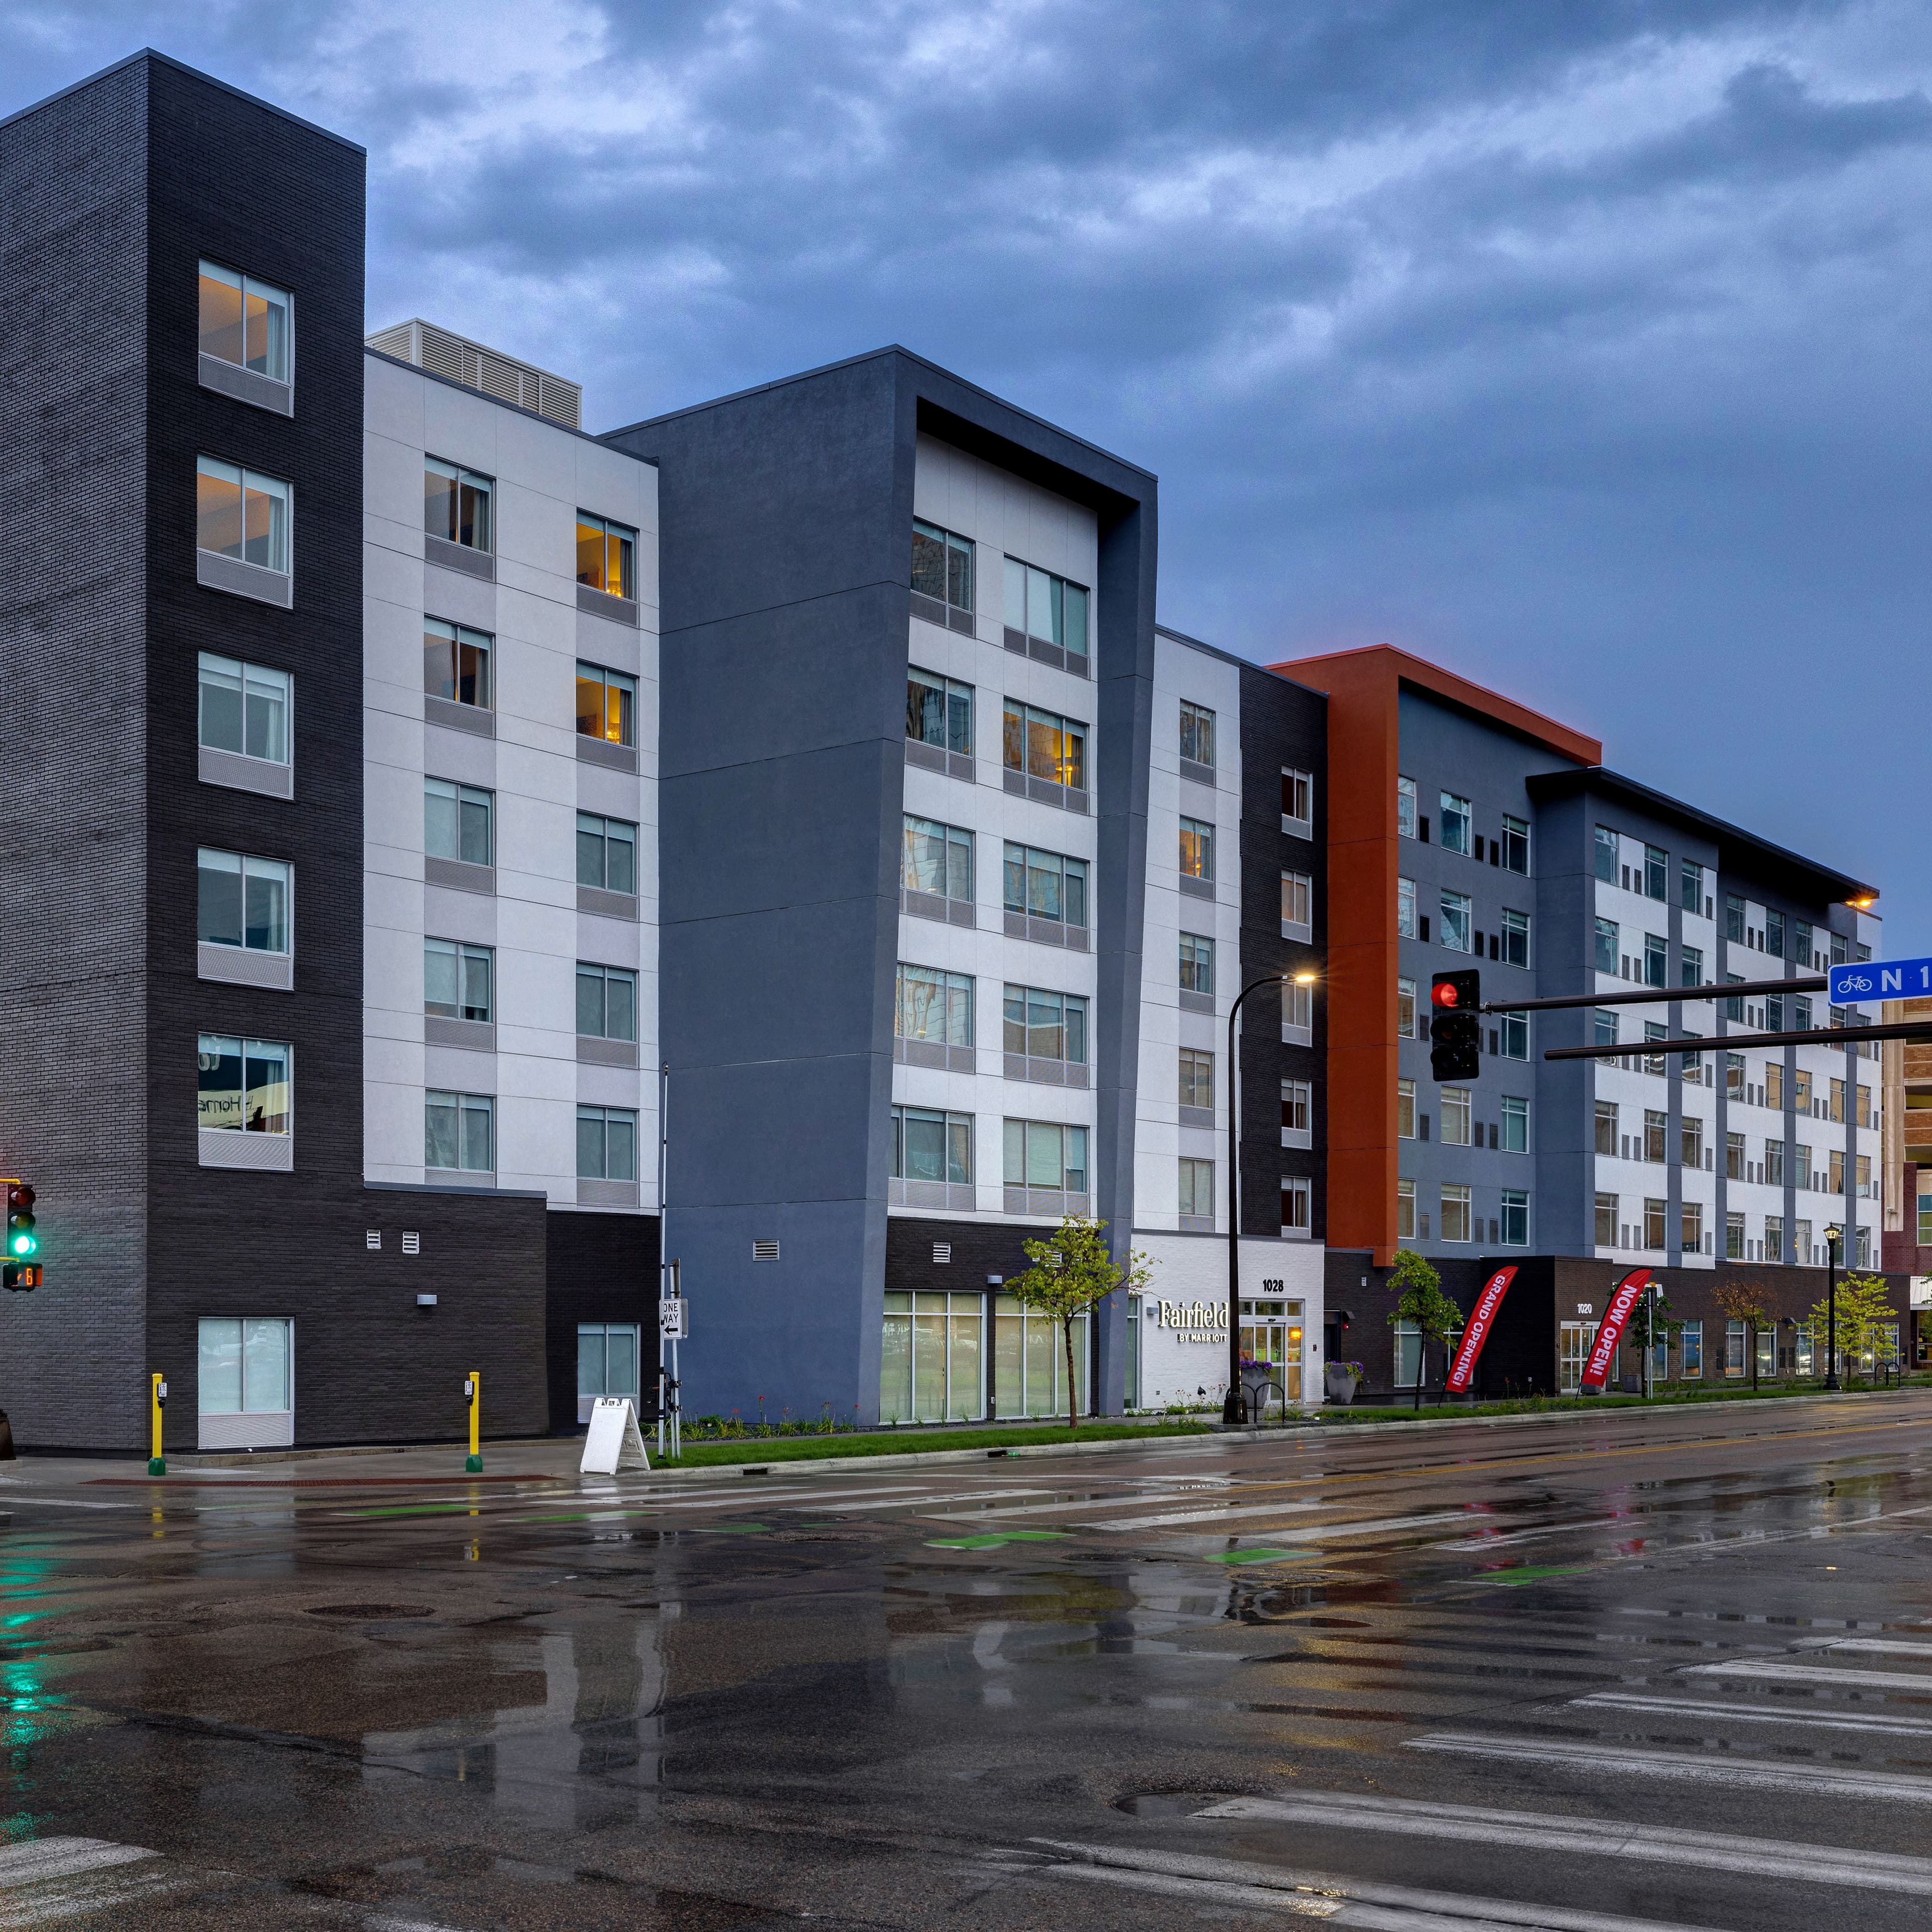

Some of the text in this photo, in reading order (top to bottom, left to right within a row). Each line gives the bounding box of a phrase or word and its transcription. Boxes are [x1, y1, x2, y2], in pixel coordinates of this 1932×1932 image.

[1882, 965, 1929, 992] N 1
[1263, 1279, 1284, 1292] 1028
[1158, 1300, 1229, 1328] Fairfield
[1577, 1303, 1592, 1314] 1020
[1178, 1333, 1228, 1343] BY MARRIOTT
[1452, 1274, 1505, 1386] GRAND OPENING!
[1589, 1284, 1637, 1376] NOW OPEN!
